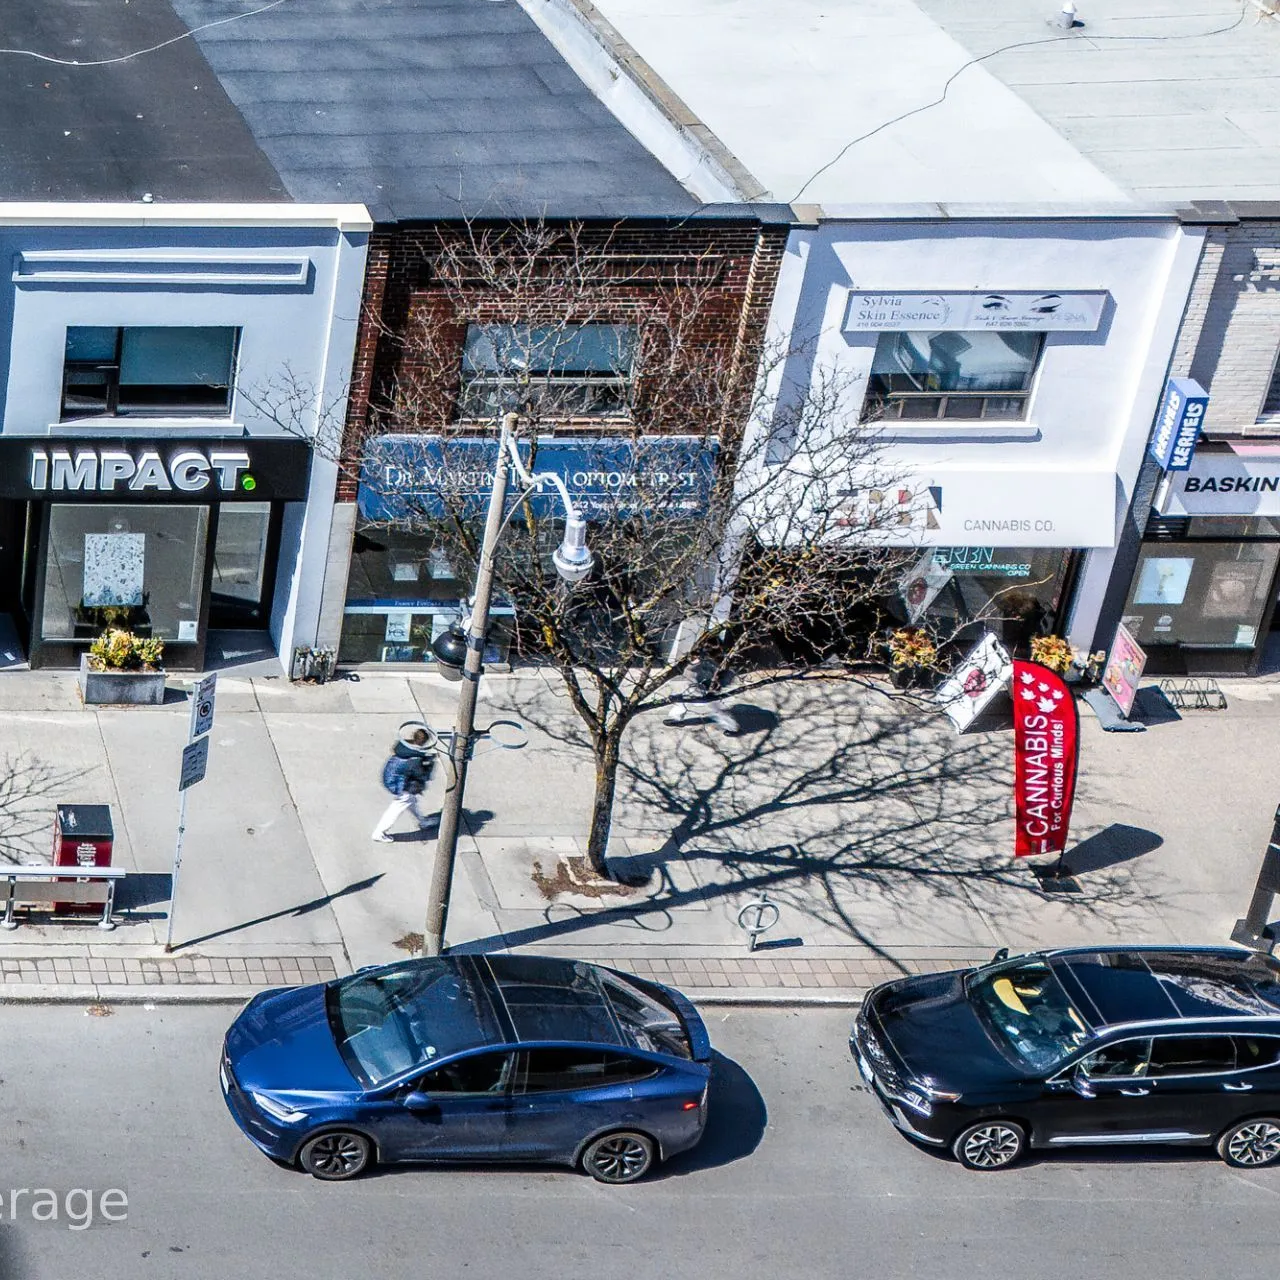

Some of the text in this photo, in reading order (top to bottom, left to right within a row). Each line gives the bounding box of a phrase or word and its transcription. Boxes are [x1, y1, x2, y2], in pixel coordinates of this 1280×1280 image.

[861, 296, 902, 308] Sylvia
[858, 310, 940, 320] Skin Essence
[1171, 403, 1203, 467] KERNELS
[1184, 477, 1280, 492] BASKIN
[964, 520, 1056, 532] CANNABIS CO.
[1024, 715, 1049, 837] CANNABIS
[1051, 719, 1064, 832] For Curious Minds!
